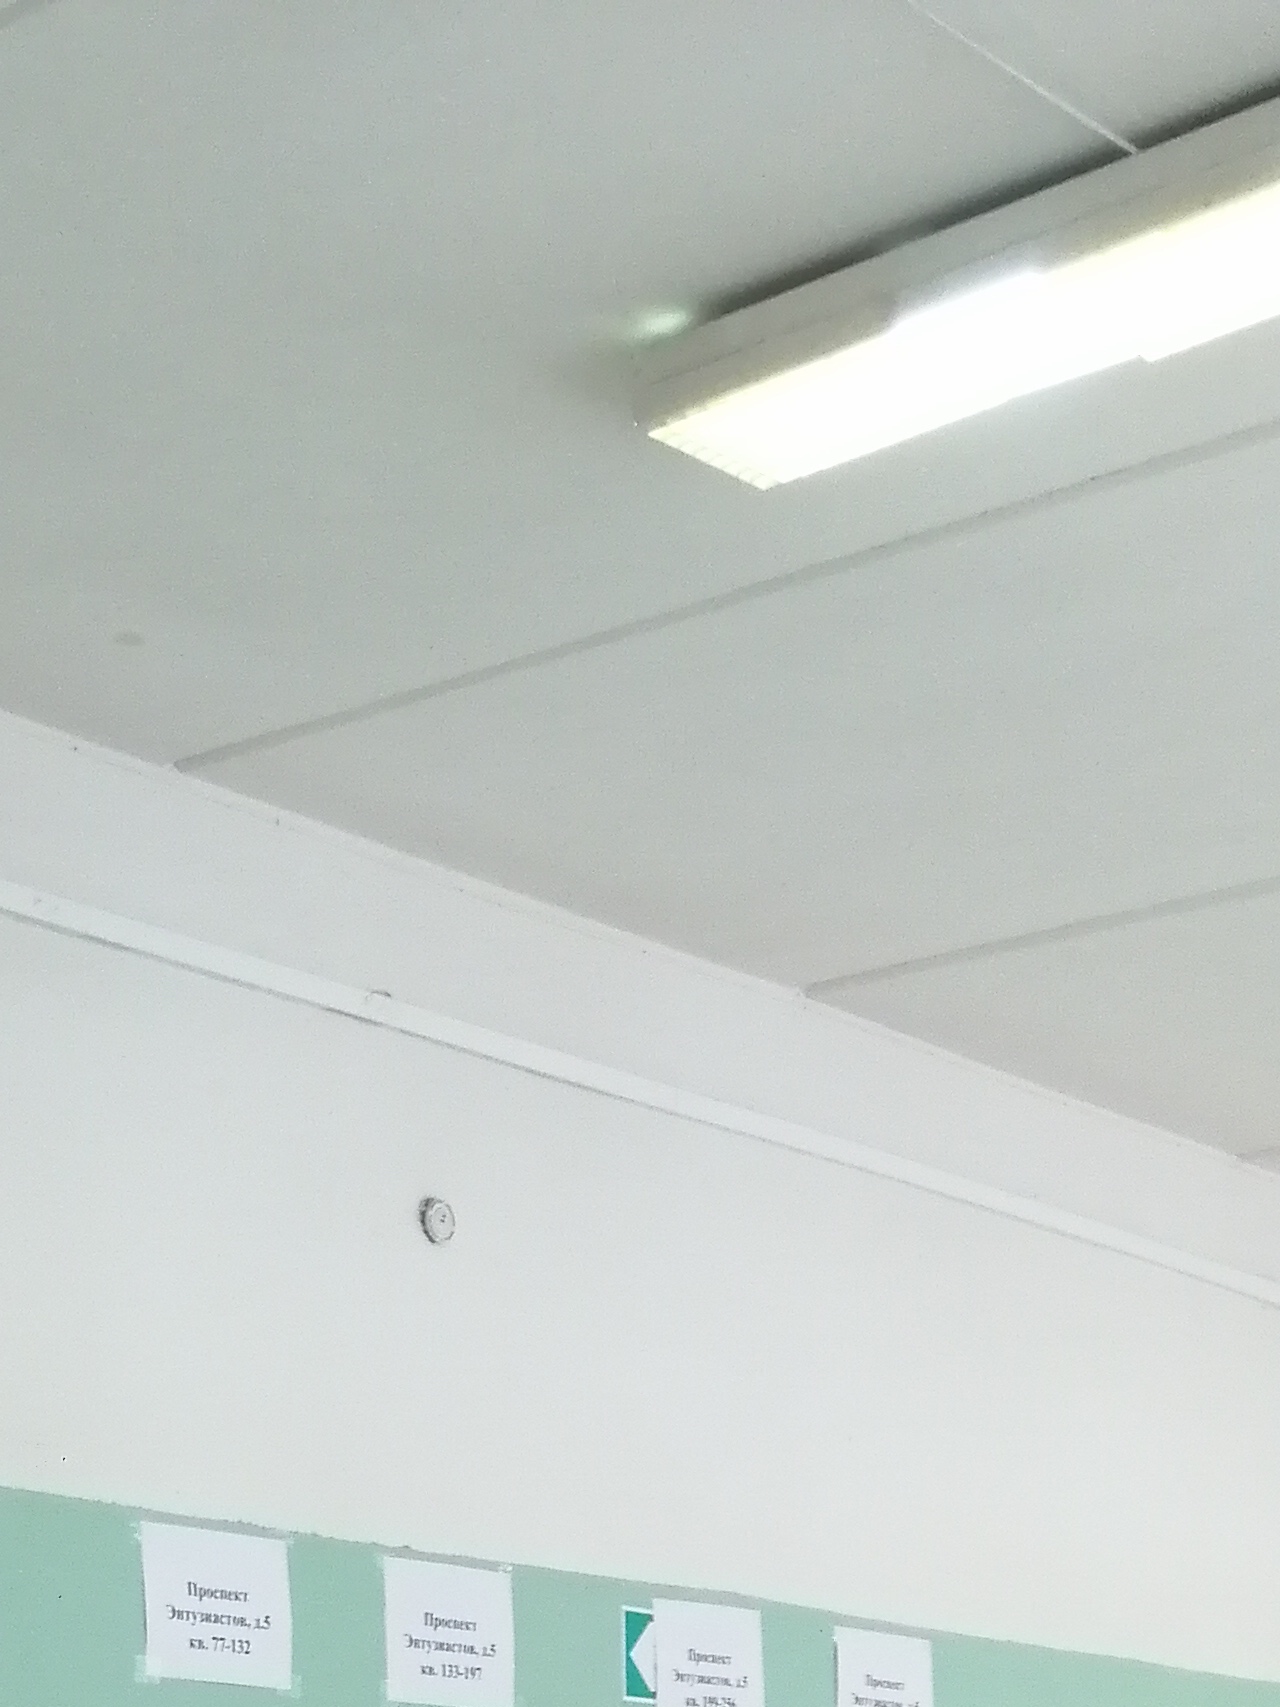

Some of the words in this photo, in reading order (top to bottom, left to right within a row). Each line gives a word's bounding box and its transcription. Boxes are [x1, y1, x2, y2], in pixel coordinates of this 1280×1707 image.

[186, 1580, 249, 1602] Проспект
[423, 1611, 478, 1632] Проспект
[211, 1636, 252, 1655] 77-132
